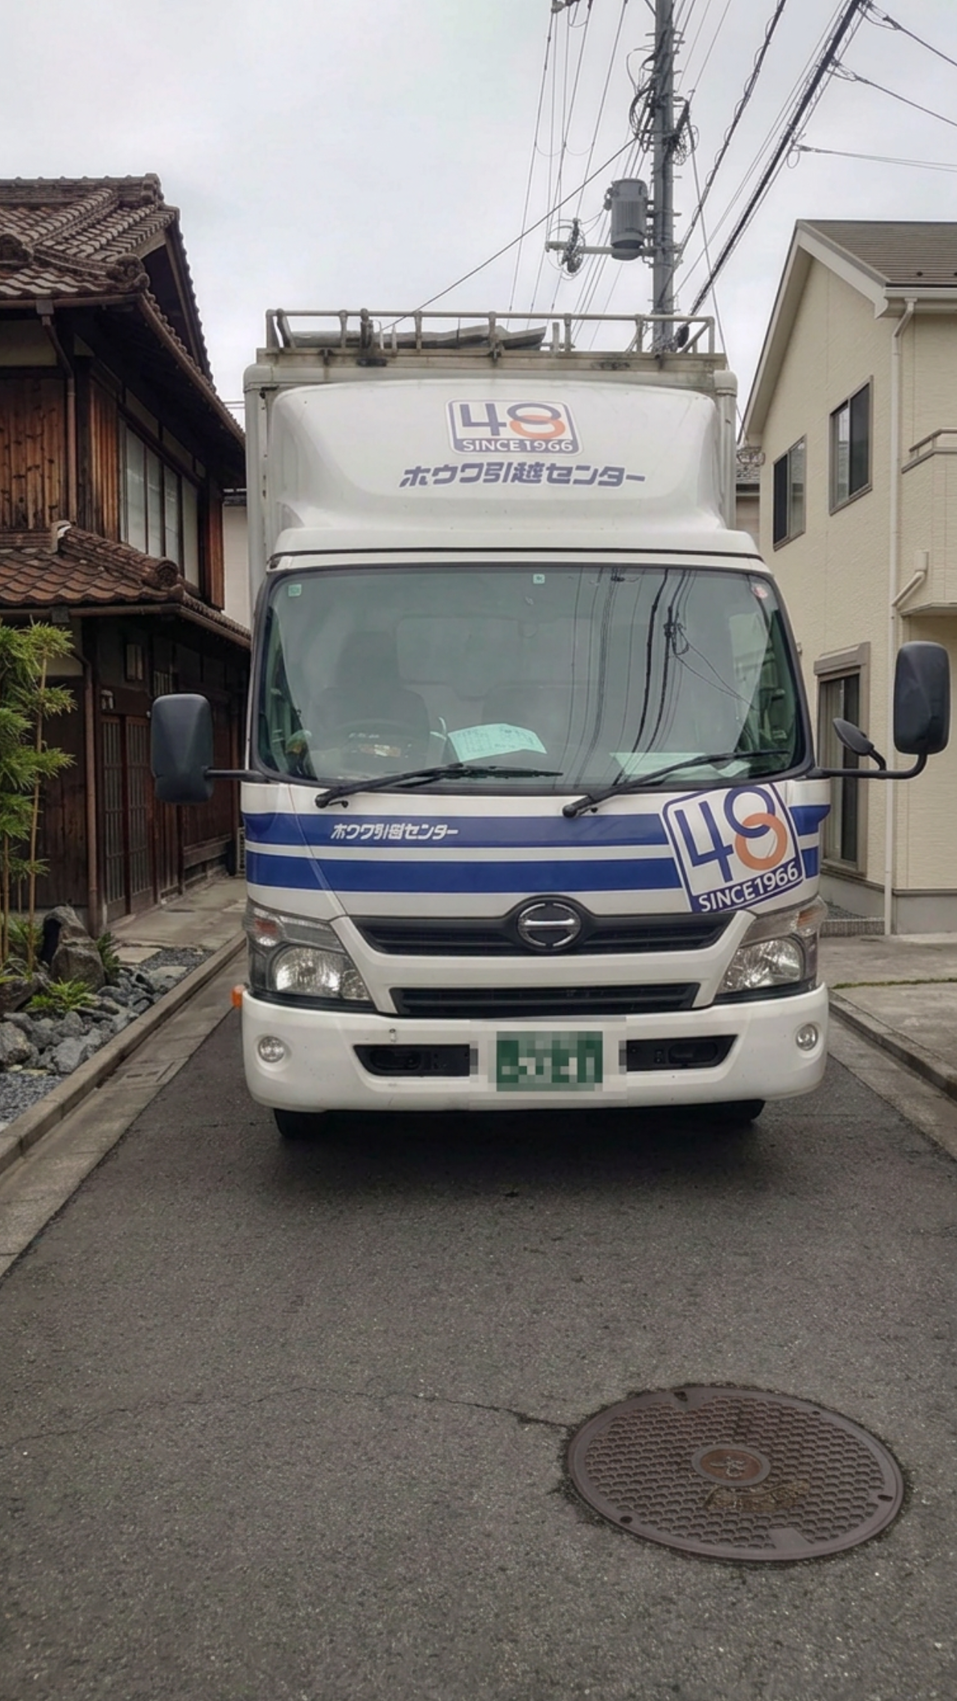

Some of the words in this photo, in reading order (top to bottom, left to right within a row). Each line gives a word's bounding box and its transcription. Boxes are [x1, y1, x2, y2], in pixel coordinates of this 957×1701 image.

[399, 461, 645, 487] ホウワ引越センター
